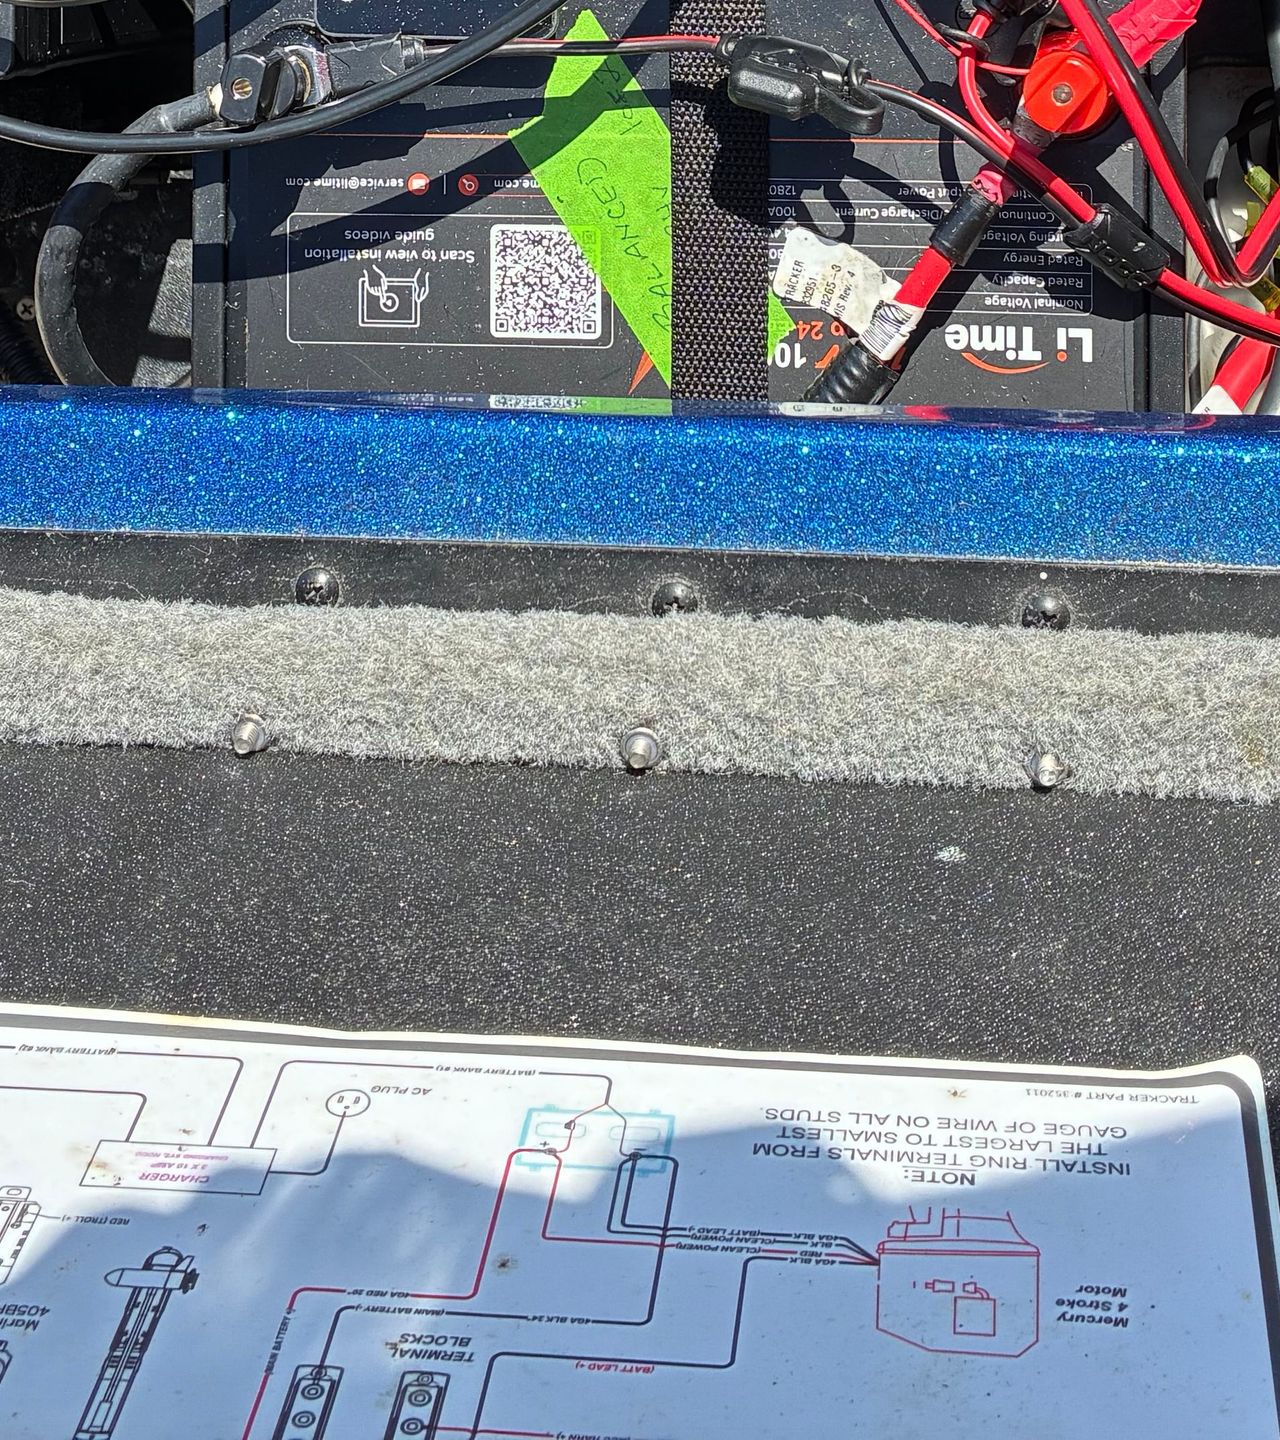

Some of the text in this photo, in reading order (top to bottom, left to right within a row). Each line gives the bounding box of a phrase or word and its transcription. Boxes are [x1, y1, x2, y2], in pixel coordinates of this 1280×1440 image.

[285, 176, 405, 189] service@litime.com
[898, 187, 939, 198] Power
[835, 207, 875, 219] Current
[344, 228, 435, 242] guide videos
[304, 248, 475, 264] Scan to view installation
[1003, 253, 1084, 266] Rated Energy
[992, 274, 1084, 288] Rated Capacity
[984, 295, 1084, 309] Nominal Voltage
[797, 321, 823, 340] 24
[944, 324, 1093, 363] Li Time
[370, 1084, 432, 1096] AC PLUG
[1086, 1092, 1199, 1104] TRACKER PART
[760, 1107, 1127, 1139] GAUGE OF WIRE ON ALL STUDS.
[776, 1125, 1108, 1156] THE LARGEST TO SMALLEST
[752, 1142, 1130, 1176] INSTALL RING TERMINALS FROM
[902, 1169, 976, 1187] NOTE:
[675, 1242, 724, 1252] POWER)
[799, 1250, 823, 1258] RED
[789, 1256, 812, 1264] BLK
[1075, 1284, 1128, 1298] Motor
[1055, 1297, 1112, 1311] Stroke
[1056, 1312, 1129, 1328] Mercury
[398, 1333, 472, 1347] BLOCKS
[388, 1346, 475, 1362] TERMINAL
